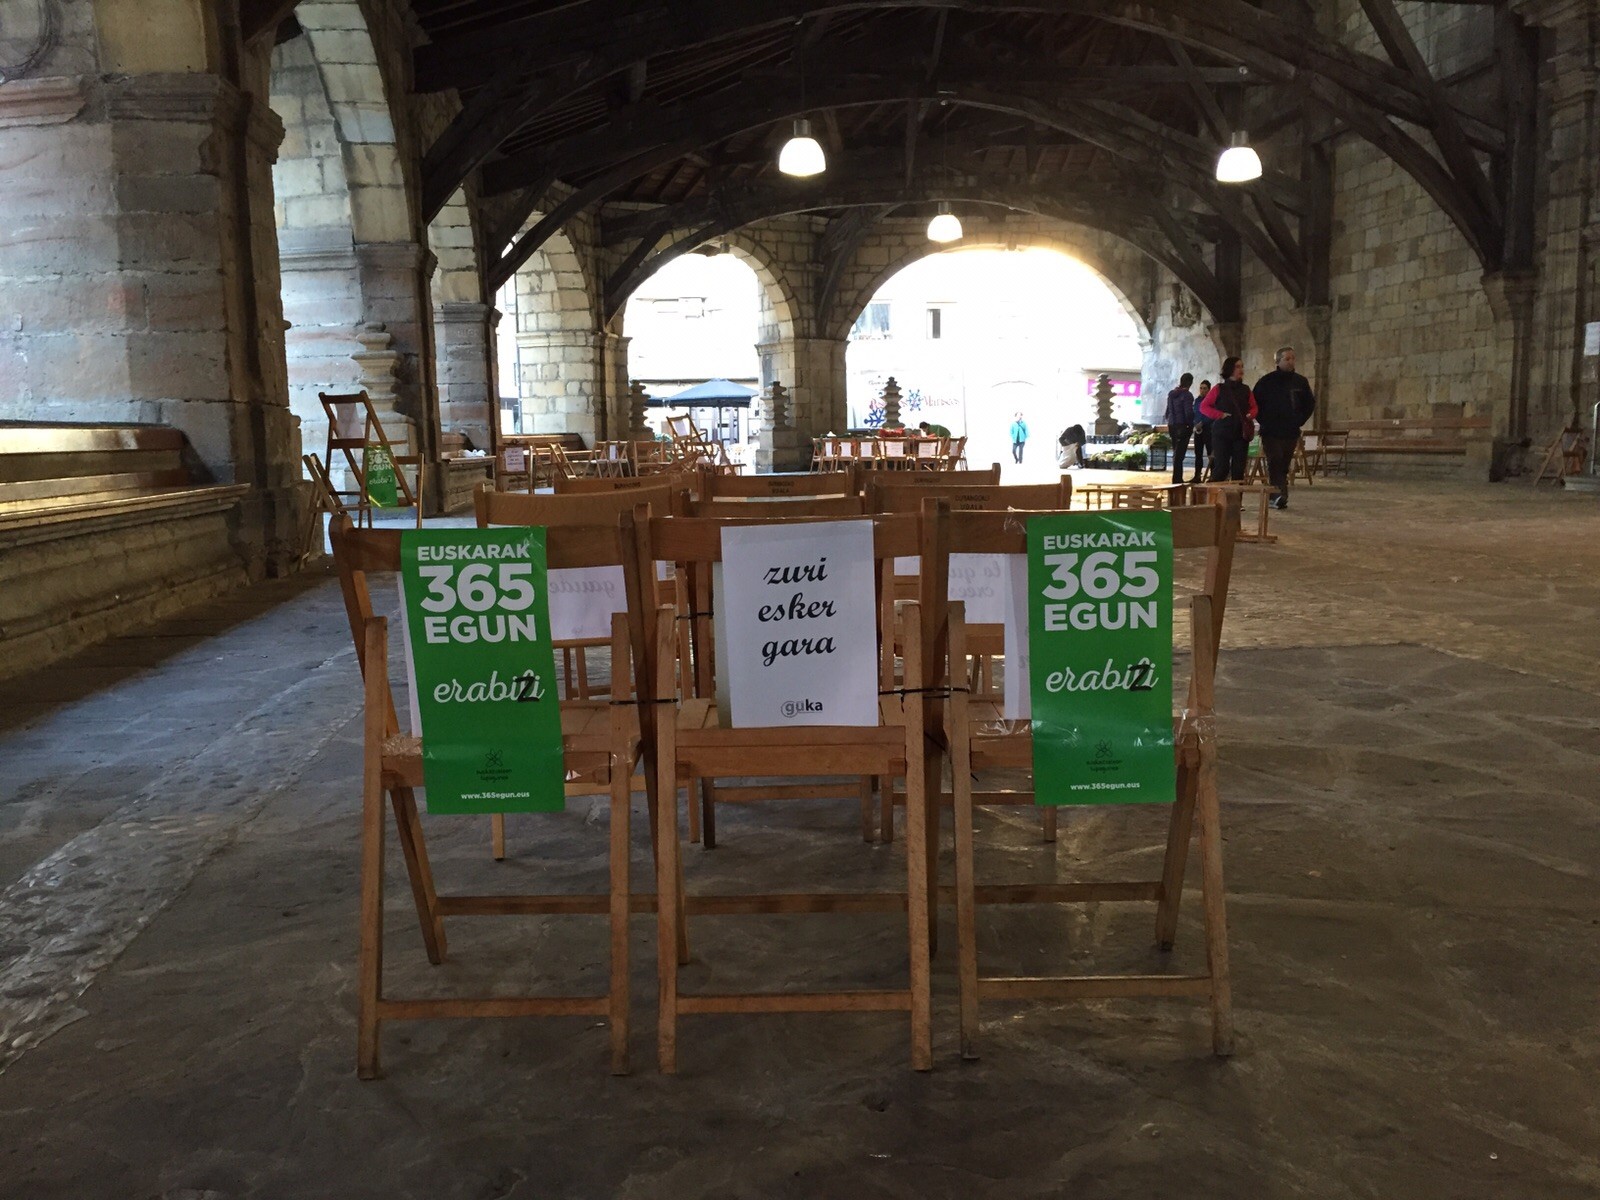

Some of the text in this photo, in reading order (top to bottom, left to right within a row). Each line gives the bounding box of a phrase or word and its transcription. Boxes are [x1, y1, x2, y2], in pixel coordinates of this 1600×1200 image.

[417, 544, 531, 562] EUSKARAK
[1043, 531, 1156, 550] EUSKARAK
[763, 557, 828, 585] zuri
[1042, 551, 1160, 600] 365
[419, 563, 536, 613] 365
[758, 592, 837, 623] esker
[1044, 602, 1158, 631] EGUN
[424, 614, 538, 644] EGUN
[761, 636, 837, 667] gara
[461, 791, 531, 800] www.365egun.eus
[1070, 782, 1141, 791] www.365egun.eus
